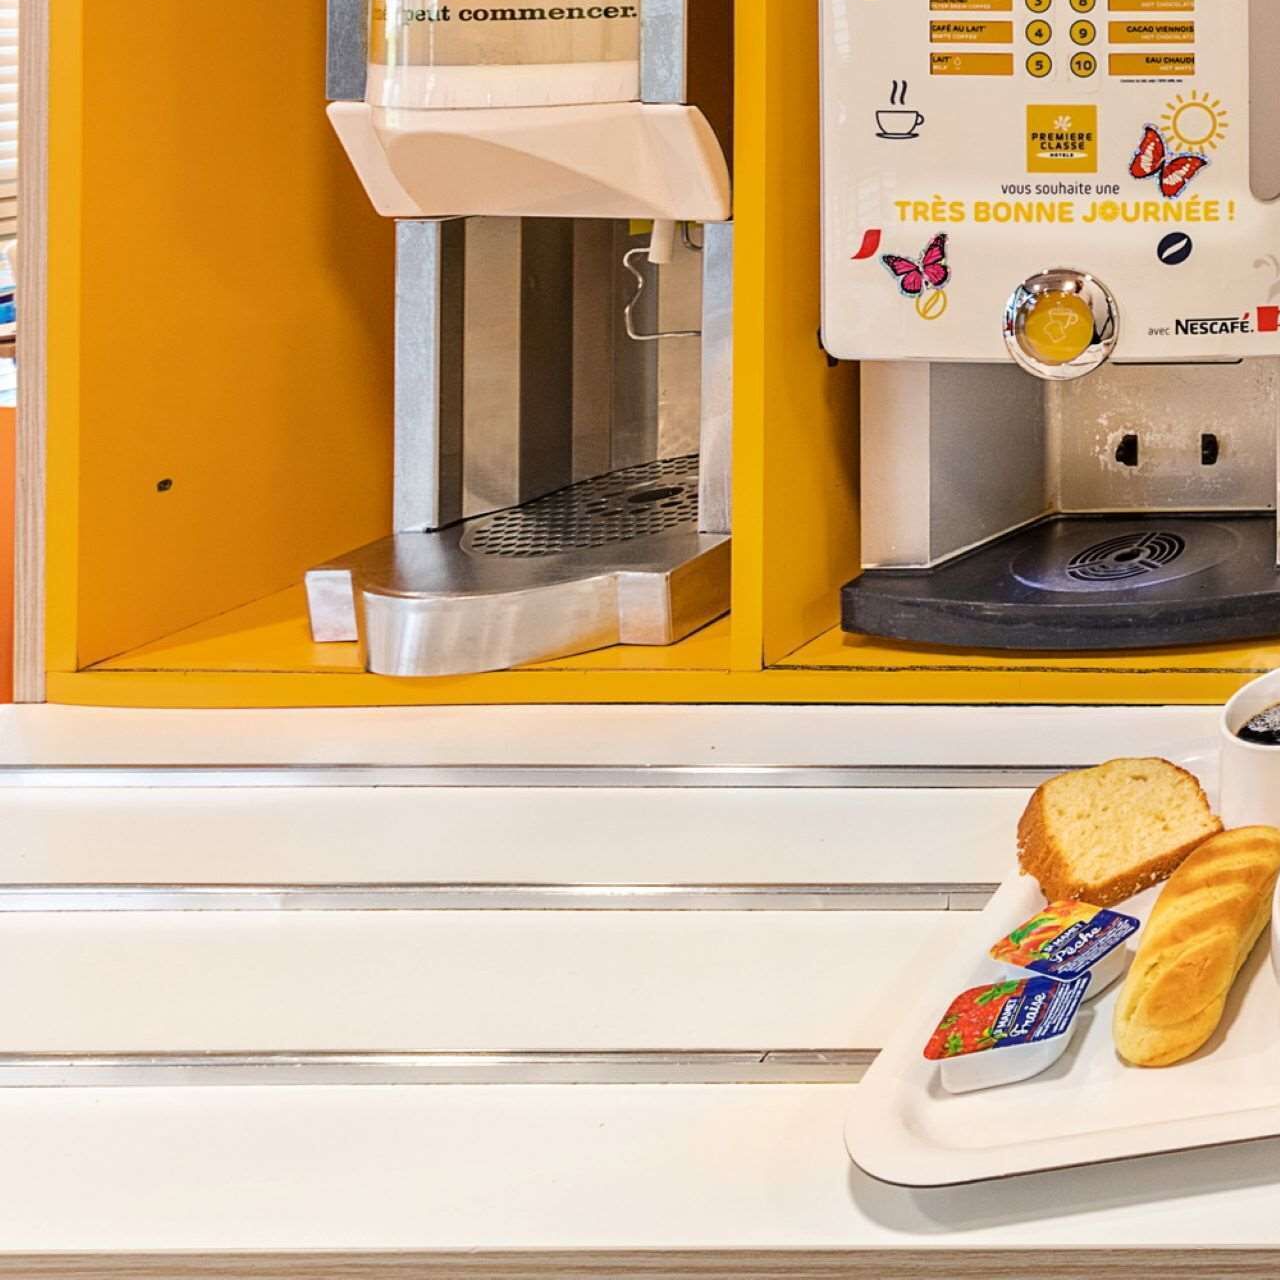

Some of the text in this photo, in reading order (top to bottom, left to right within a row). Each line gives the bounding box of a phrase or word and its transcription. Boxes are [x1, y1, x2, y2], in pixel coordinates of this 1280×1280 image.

[457, 4, 639, 23] commencer.
[932, 24, 951, 32] CAFÉ
[953, 24, 965, 32] AU
[1034, 28, 1043, 38] 4
[1078, 28, 1088, 39] 9
[1126, 25, 1194, 33] CACAO VIENNOIS
[1035, 60, 1043, 71] 5
[1075, 60, 1092, 71] 10
[1032, 131, 1093, 141] PREMIERE
[1039, 140, 1086, 151] CLASSE
[1001, 181, 1120, 196] vous souhaite une
[894, 194, 1236, 223] TRÈS BONNE JOURNÉE !
[1147, 327, 1171, 336] avec
[1009, 991, 1047, 1037] Fraise
